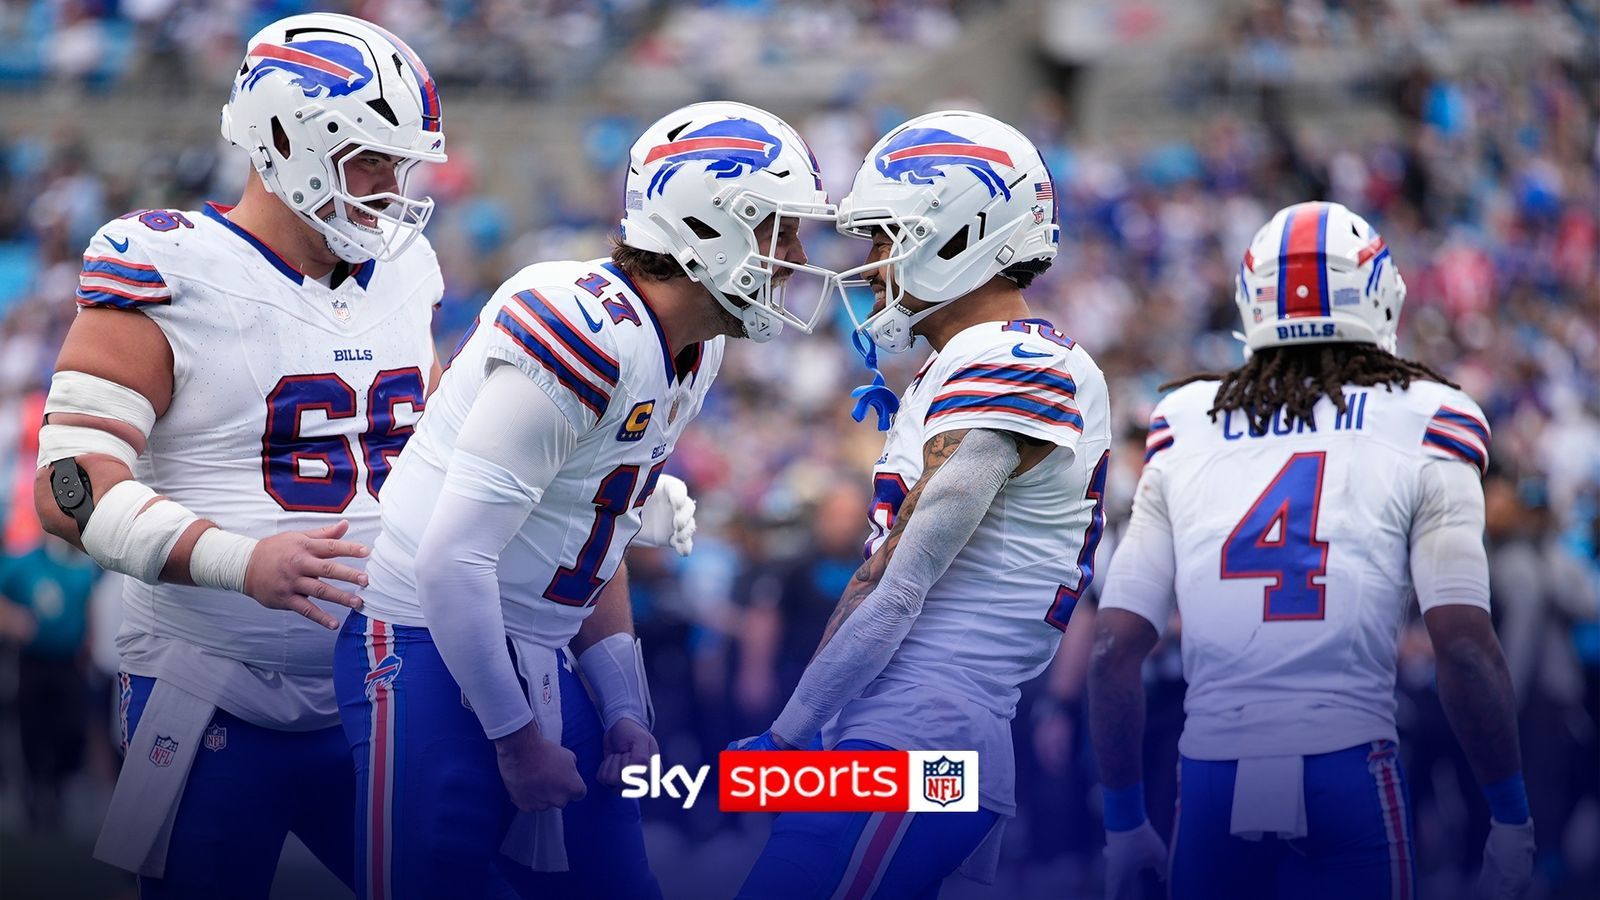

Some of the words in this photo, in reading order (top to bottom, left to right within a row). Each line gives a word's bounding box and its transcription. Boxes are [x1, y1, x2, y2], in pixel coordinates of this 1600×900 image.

[118, 209, 195, 232] 6
[575, 272, 642, 327] 17
[1276, 323, 1335, 340] BILLS
[333, 349, 373, 361] BILLS
[261, 366, 425, 514] 66
[542, 459, 667, 608] 1
[1220, 451, 1329, 622] 4
[208, 735, 223, 747] NFL
[152, 747, 171, 765] NFL
